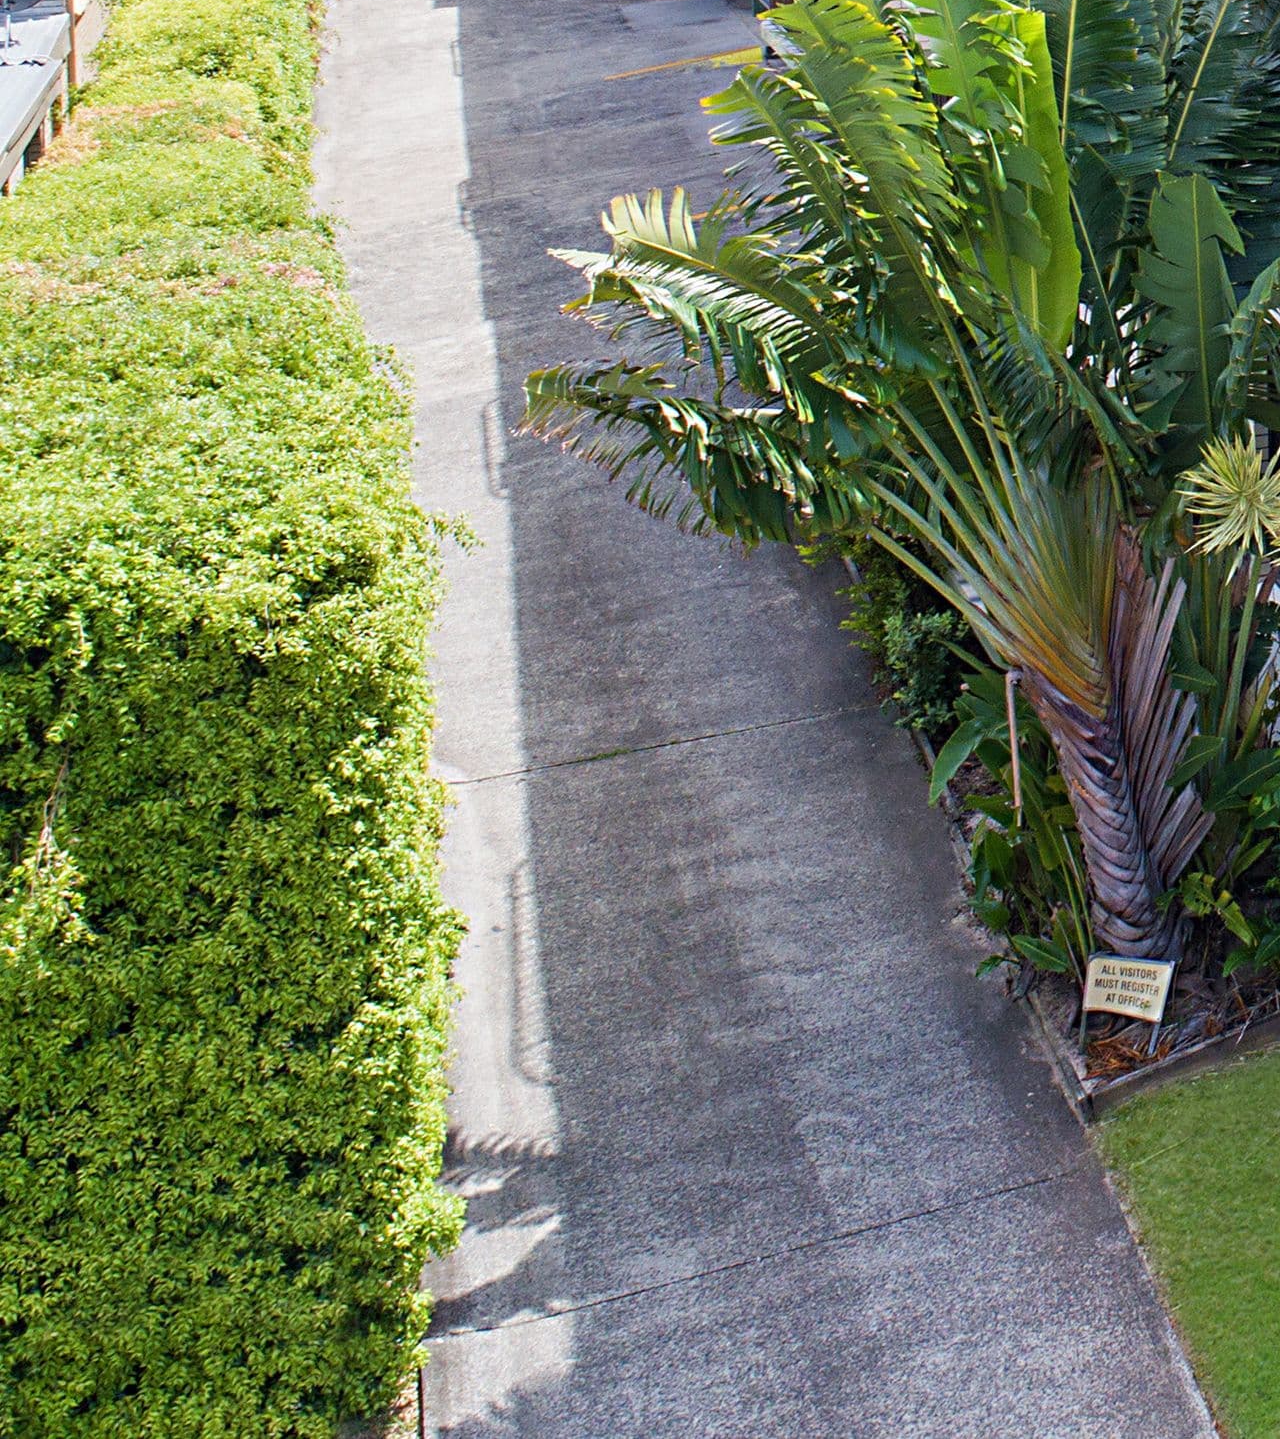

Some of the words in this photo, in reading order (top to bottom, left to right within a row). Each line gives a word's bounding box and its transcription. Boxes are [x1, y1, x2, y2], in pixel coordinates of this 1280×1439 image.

[1101, 965, 1116, 975] ALL
[1119, 967, 1158, 981] VISITORS
[1094, 978, 1119, 989] MUST
[1120, 980, 1160, 996] REGISTER
[1105, 993, 1116, 1003] AT
